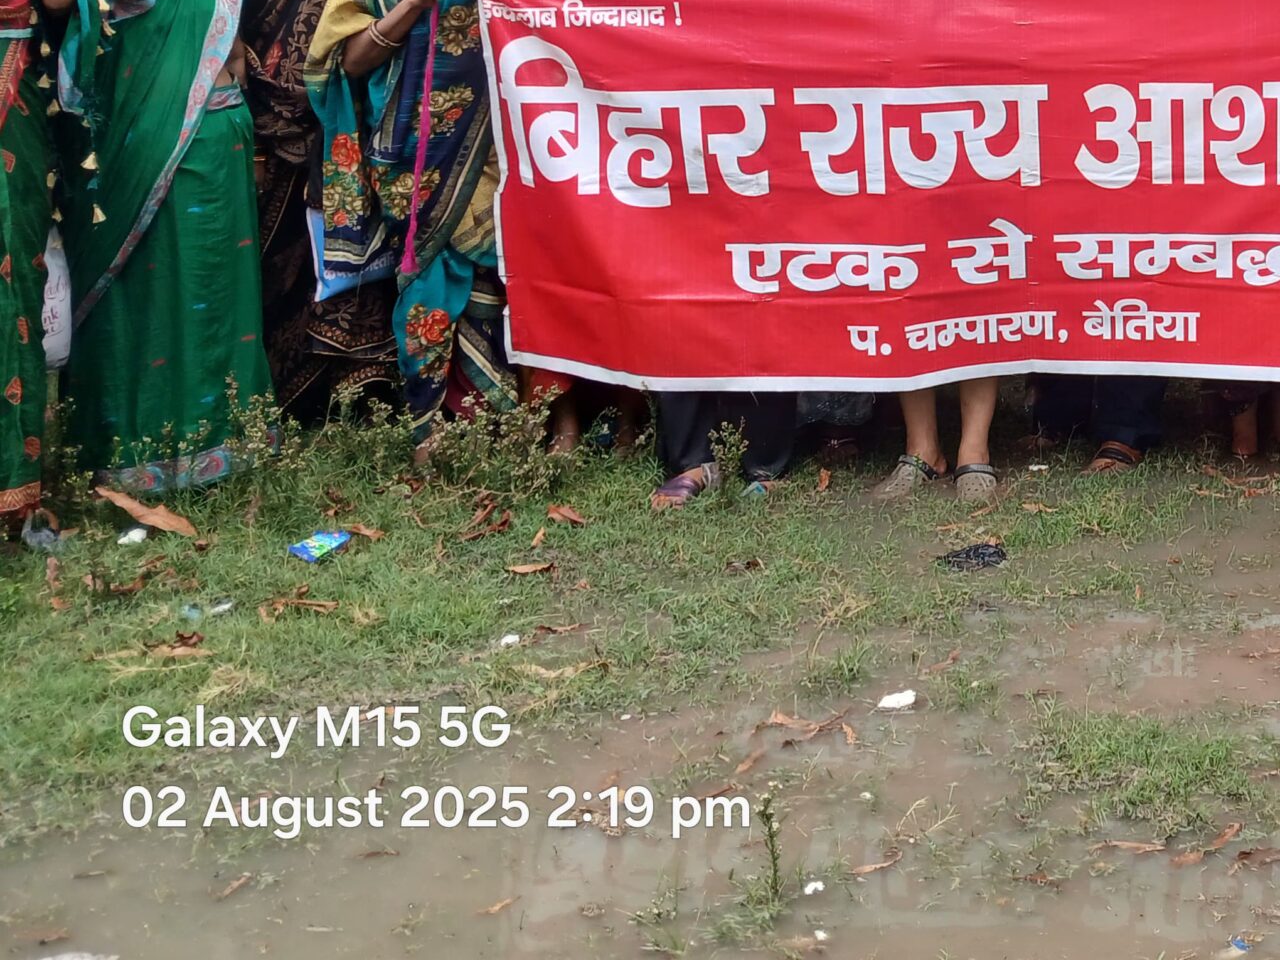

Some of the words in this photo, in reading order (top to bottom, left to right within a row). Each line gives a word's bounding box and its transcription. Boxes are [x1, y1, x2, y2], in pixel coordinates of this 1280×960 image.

[499, 36, 775, 208] बिहार
[793, 83, 1048, 196] राज्य
[726, 242, 926, 295] एटक
[948, 218, 1034, 285] से
[848, 325, 892, 357] प.
[905, 312, 1068, 351] चम्पारण,
[1083, 299, 1201, 342] बेतिया
